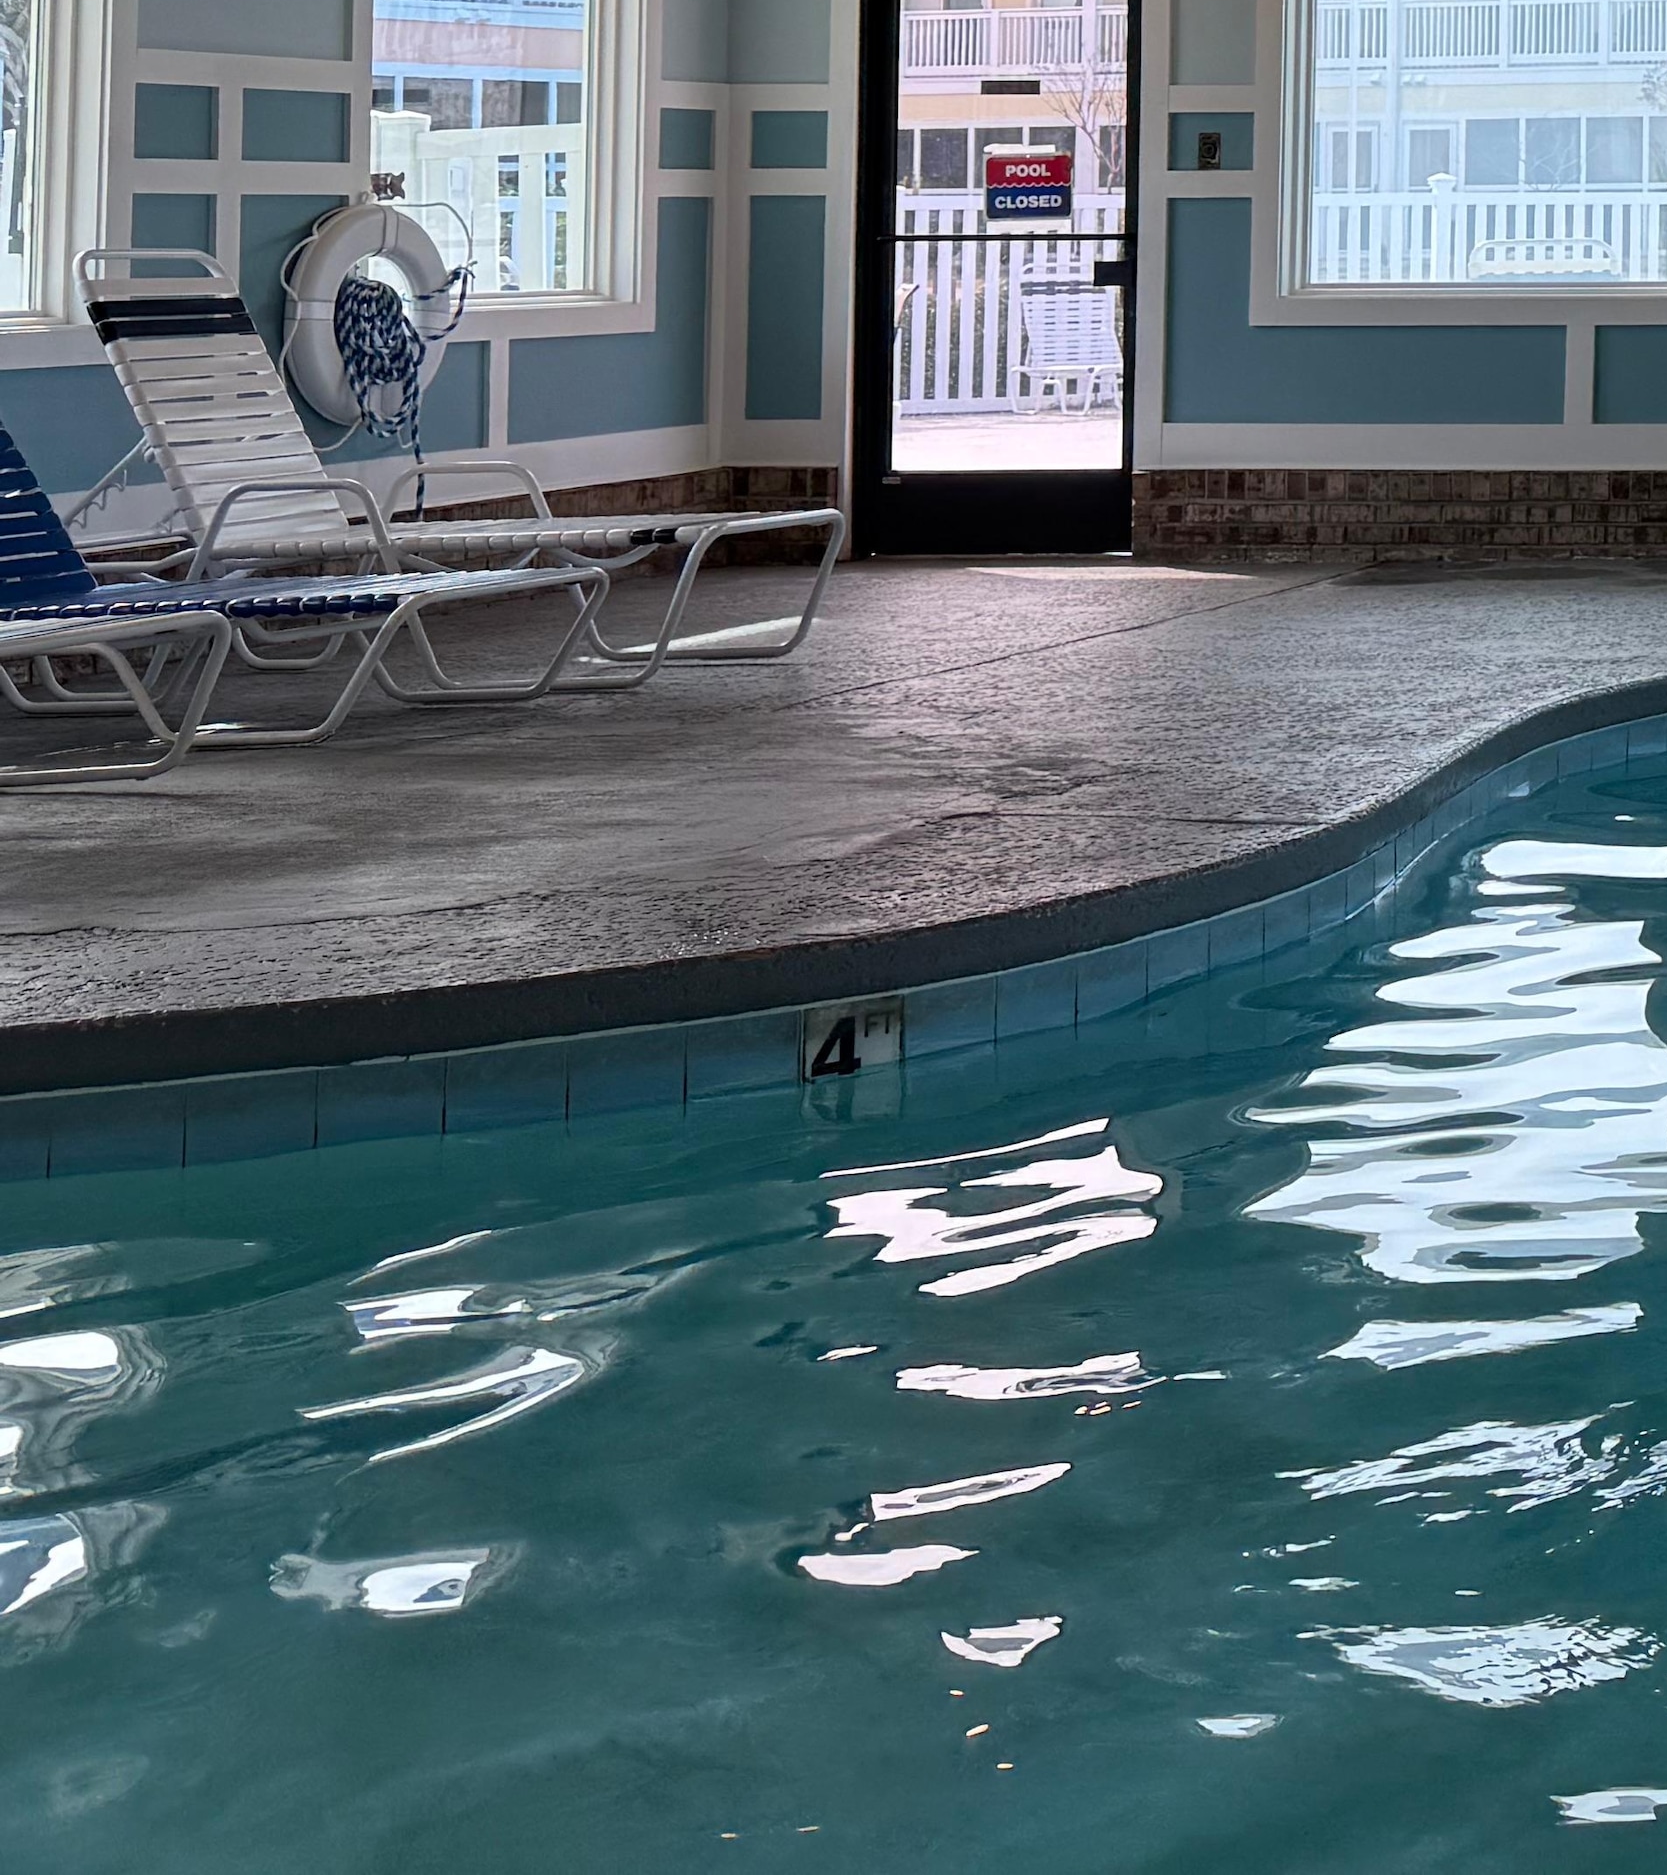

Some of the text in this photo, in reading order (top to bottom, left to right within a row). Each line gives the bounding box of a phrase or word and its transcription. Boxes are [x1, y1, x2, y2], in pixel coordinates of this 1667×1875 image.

[1005, 164, 1051, 177] POOL
[995, 194, 1062, 208] CLOSED
[811, 1008, 898, 1077] 4 FT
